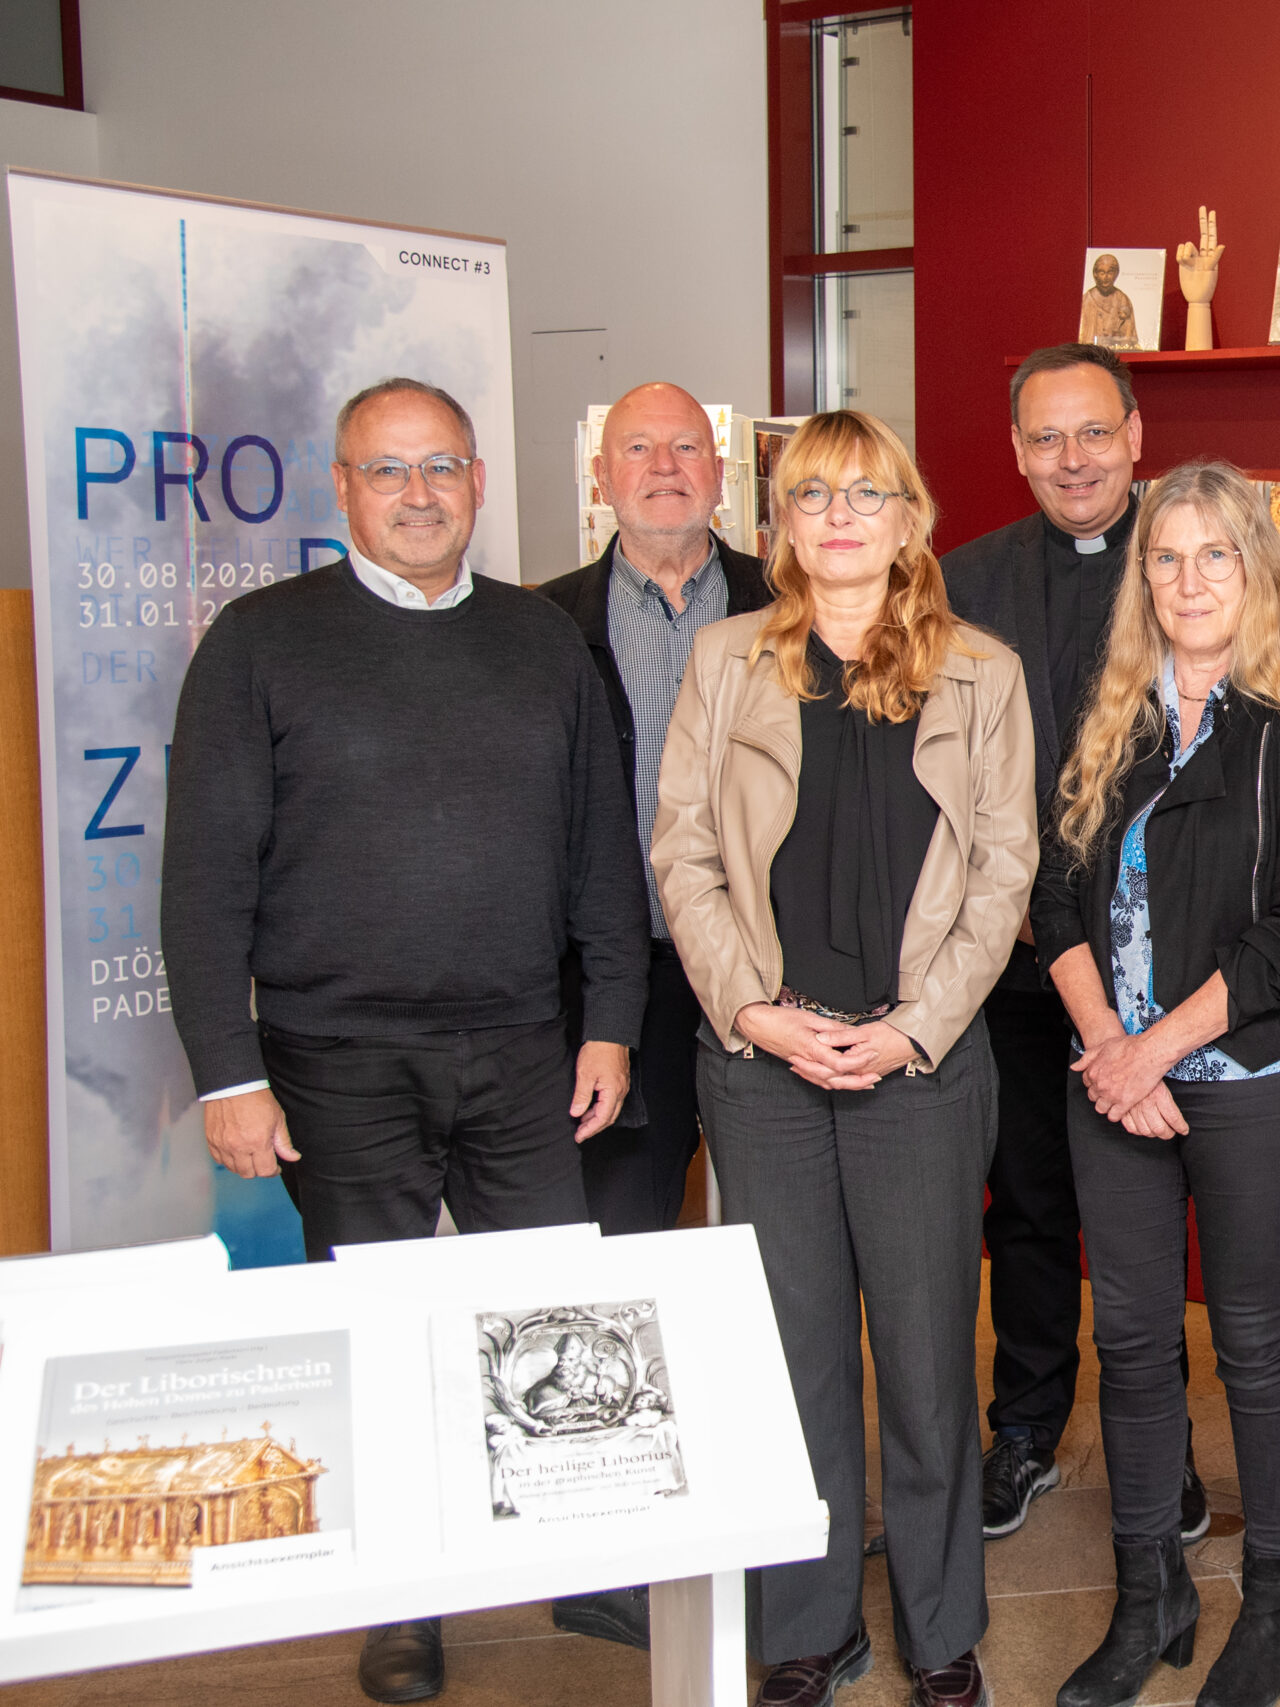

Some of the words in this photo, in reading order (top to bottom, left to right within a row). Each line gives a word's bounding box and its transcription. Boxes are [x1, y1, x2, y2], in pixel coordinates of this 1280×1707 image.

[399, 250, 470, 272] CONNECT
[474, 260, 491, 275] #3
[75, 427, 284, 523] PRO
[82, 650, 158, 685] DER
[75, 1380, 132, 1401] Der
[141, 1358, 333, 1395] Liborischrein
[501, 1466, 533, 1480] Der
[539, 1458, 596, 1475] heilige
[602, 1449, 673, 1468] Liborius
[210, 1548, 336, 1572] Ansichtsexemplar
